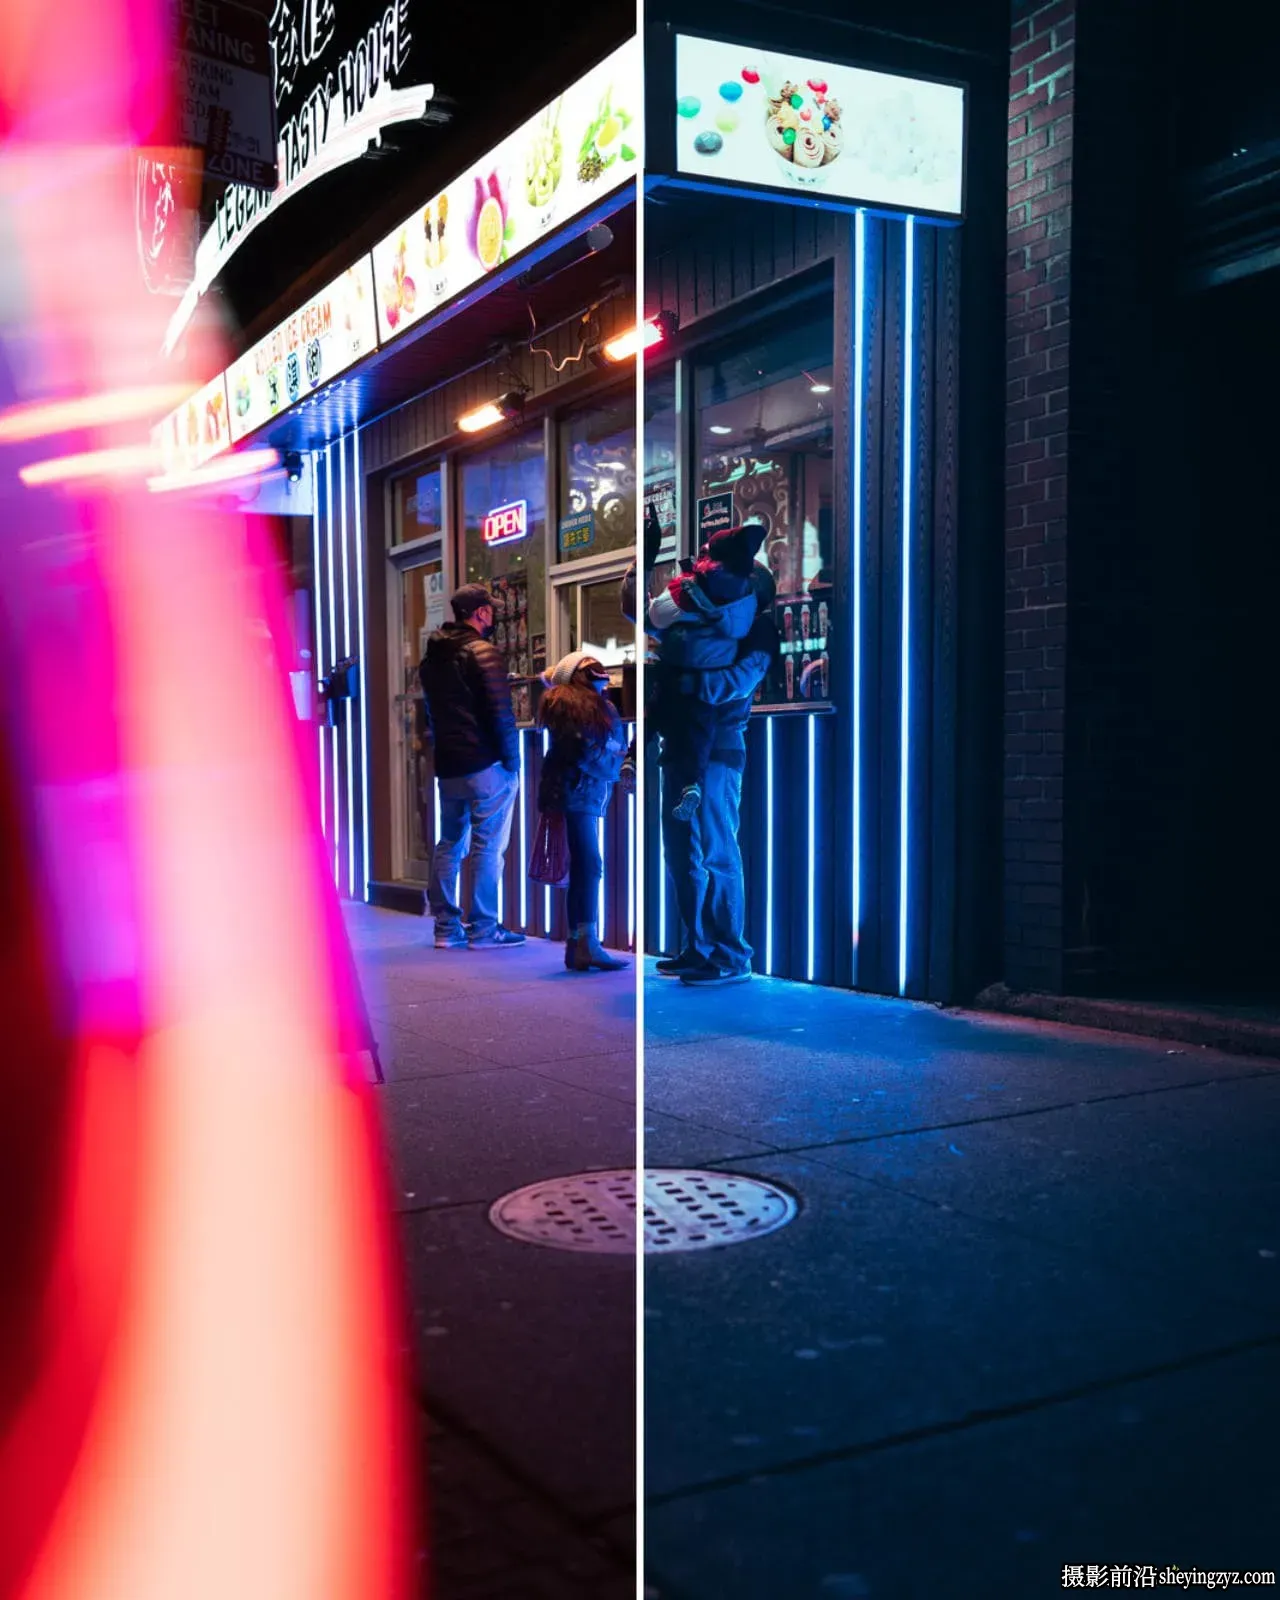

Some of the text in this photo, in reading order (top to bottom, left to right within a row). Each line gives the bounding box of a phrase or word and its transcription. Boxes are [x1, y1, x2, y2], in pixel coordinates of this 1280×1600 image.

[184, 25, 257, 65] ANING
[180, 55, 234, 86] ARKING
[279, 72, 334, 187] TASTY
[338, 0, 411, 126] HOUSE
[208, 153, 265, 183] ZONE
[301, 301, 332, 342] CREAM
[484, 507, 523, 541] OPEN
